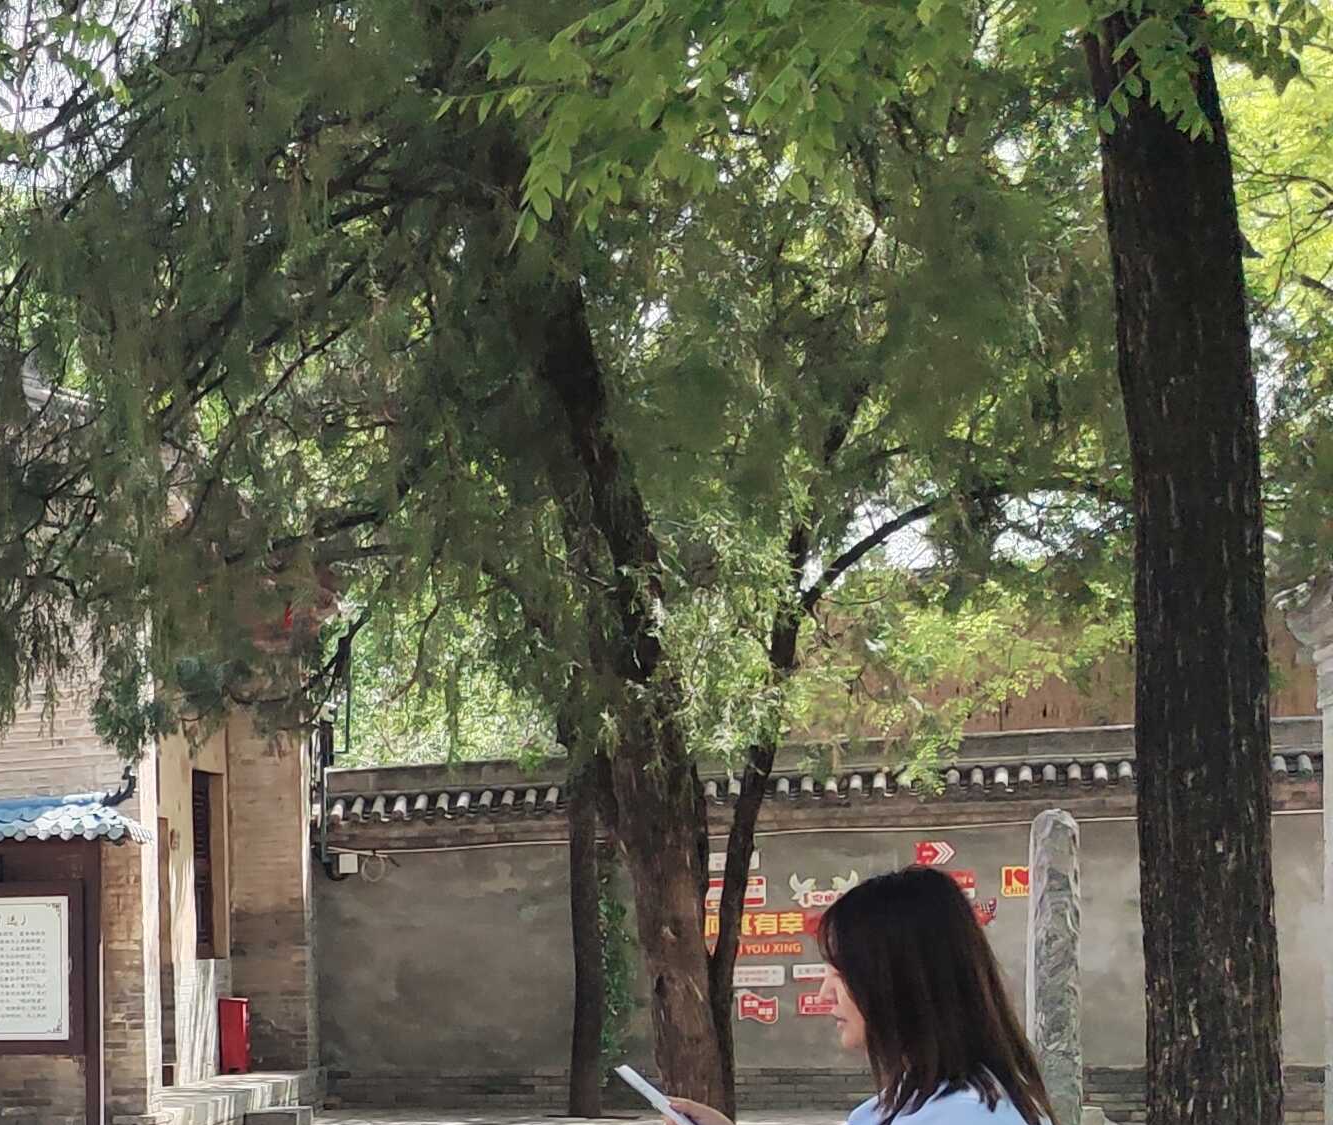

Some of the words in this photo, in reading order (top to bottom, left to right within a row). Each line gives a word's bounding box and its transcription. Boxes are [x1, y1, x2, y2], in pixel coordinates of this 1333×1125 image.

[1003, 886, 1030, 896] CHIN
[746, 943, 771, 955] YOU
[772, 942, 802, 954] XING
